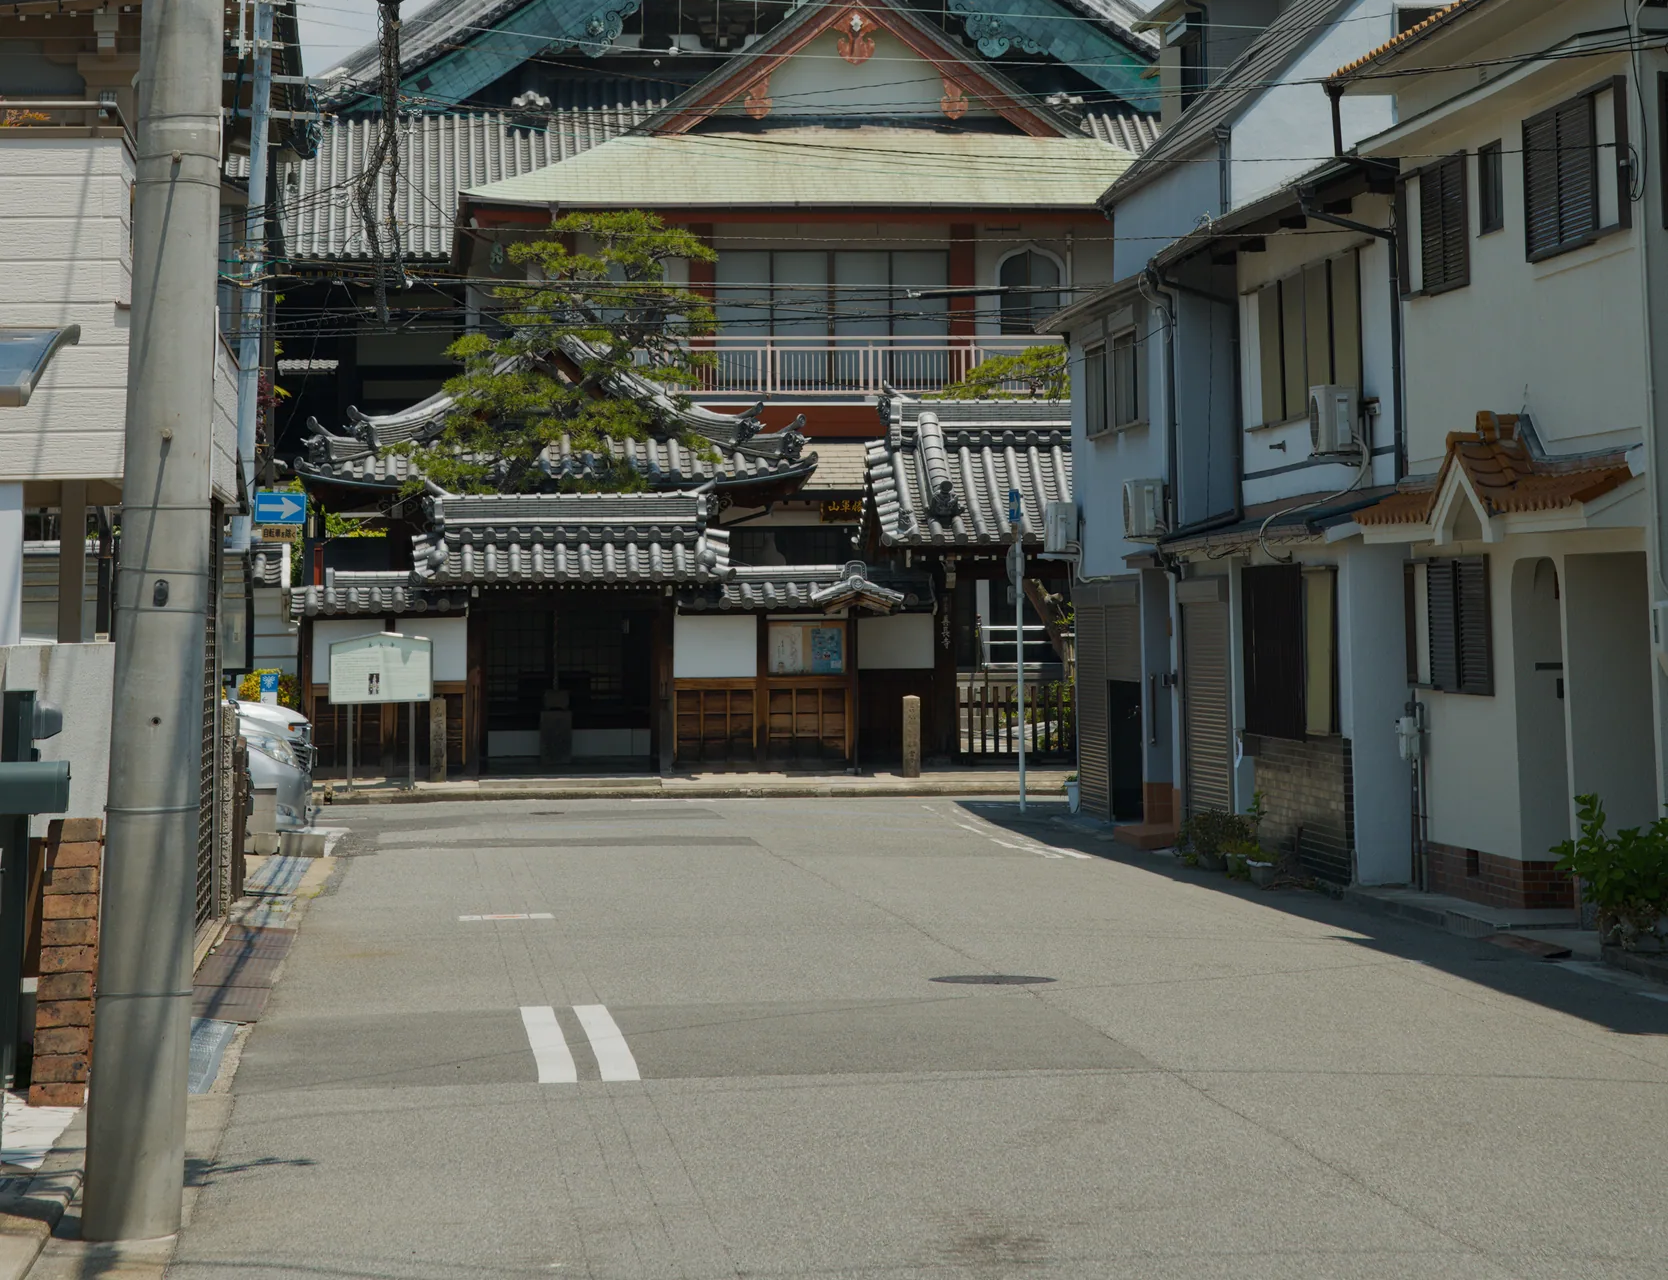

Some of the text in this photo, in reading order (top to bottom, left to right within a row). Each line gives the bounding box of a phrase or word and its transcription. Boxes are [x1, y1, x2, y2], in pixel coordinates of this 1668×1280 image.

[263, 528, 297, 539] 自転車を除く
